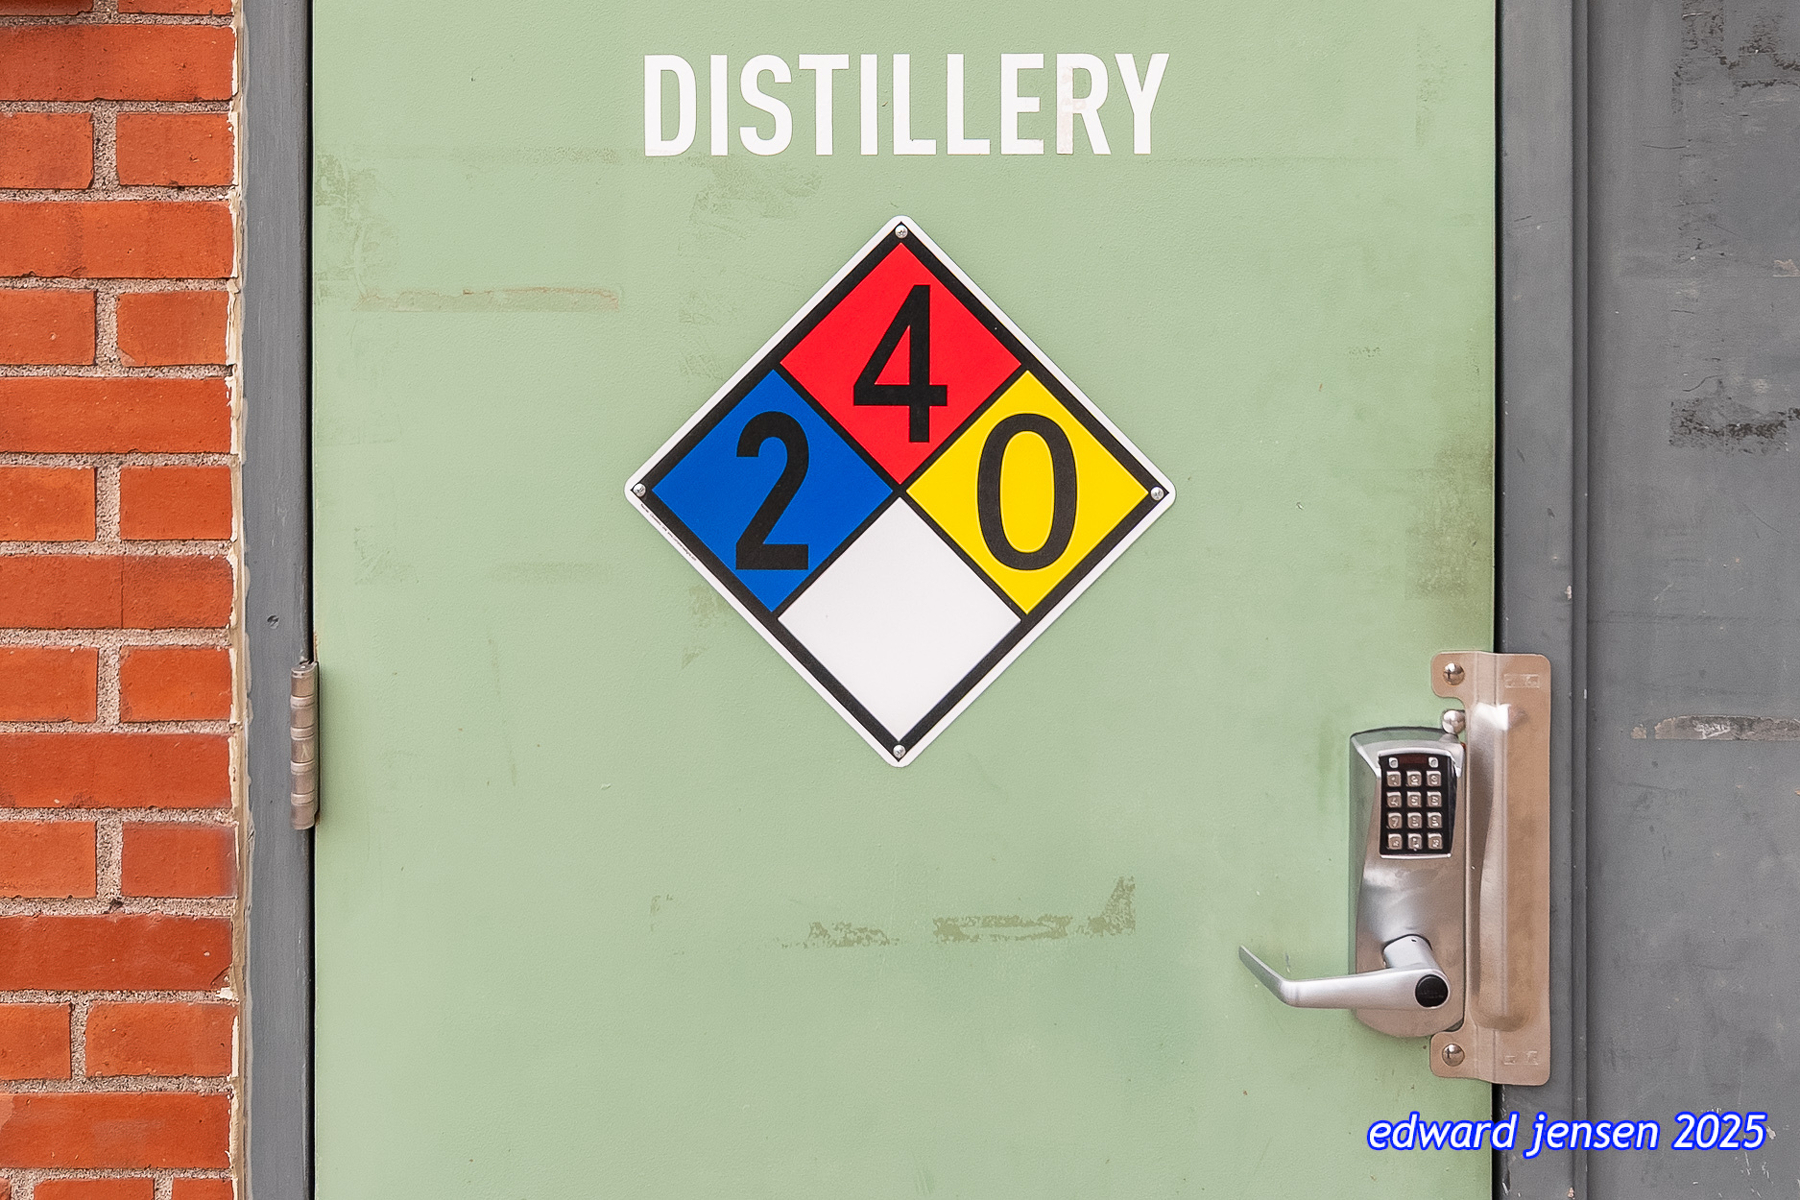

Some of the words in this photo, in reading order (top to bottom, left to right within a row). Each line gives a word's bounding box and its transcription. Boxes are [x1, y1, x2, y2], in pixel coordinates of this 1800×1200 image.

[644, 53, 1170, 157] DISTILLERY
[852, 284, 948, 444] 4
[735, 410, 810, 571] 2
[977, 413, 1078, 571] 0
